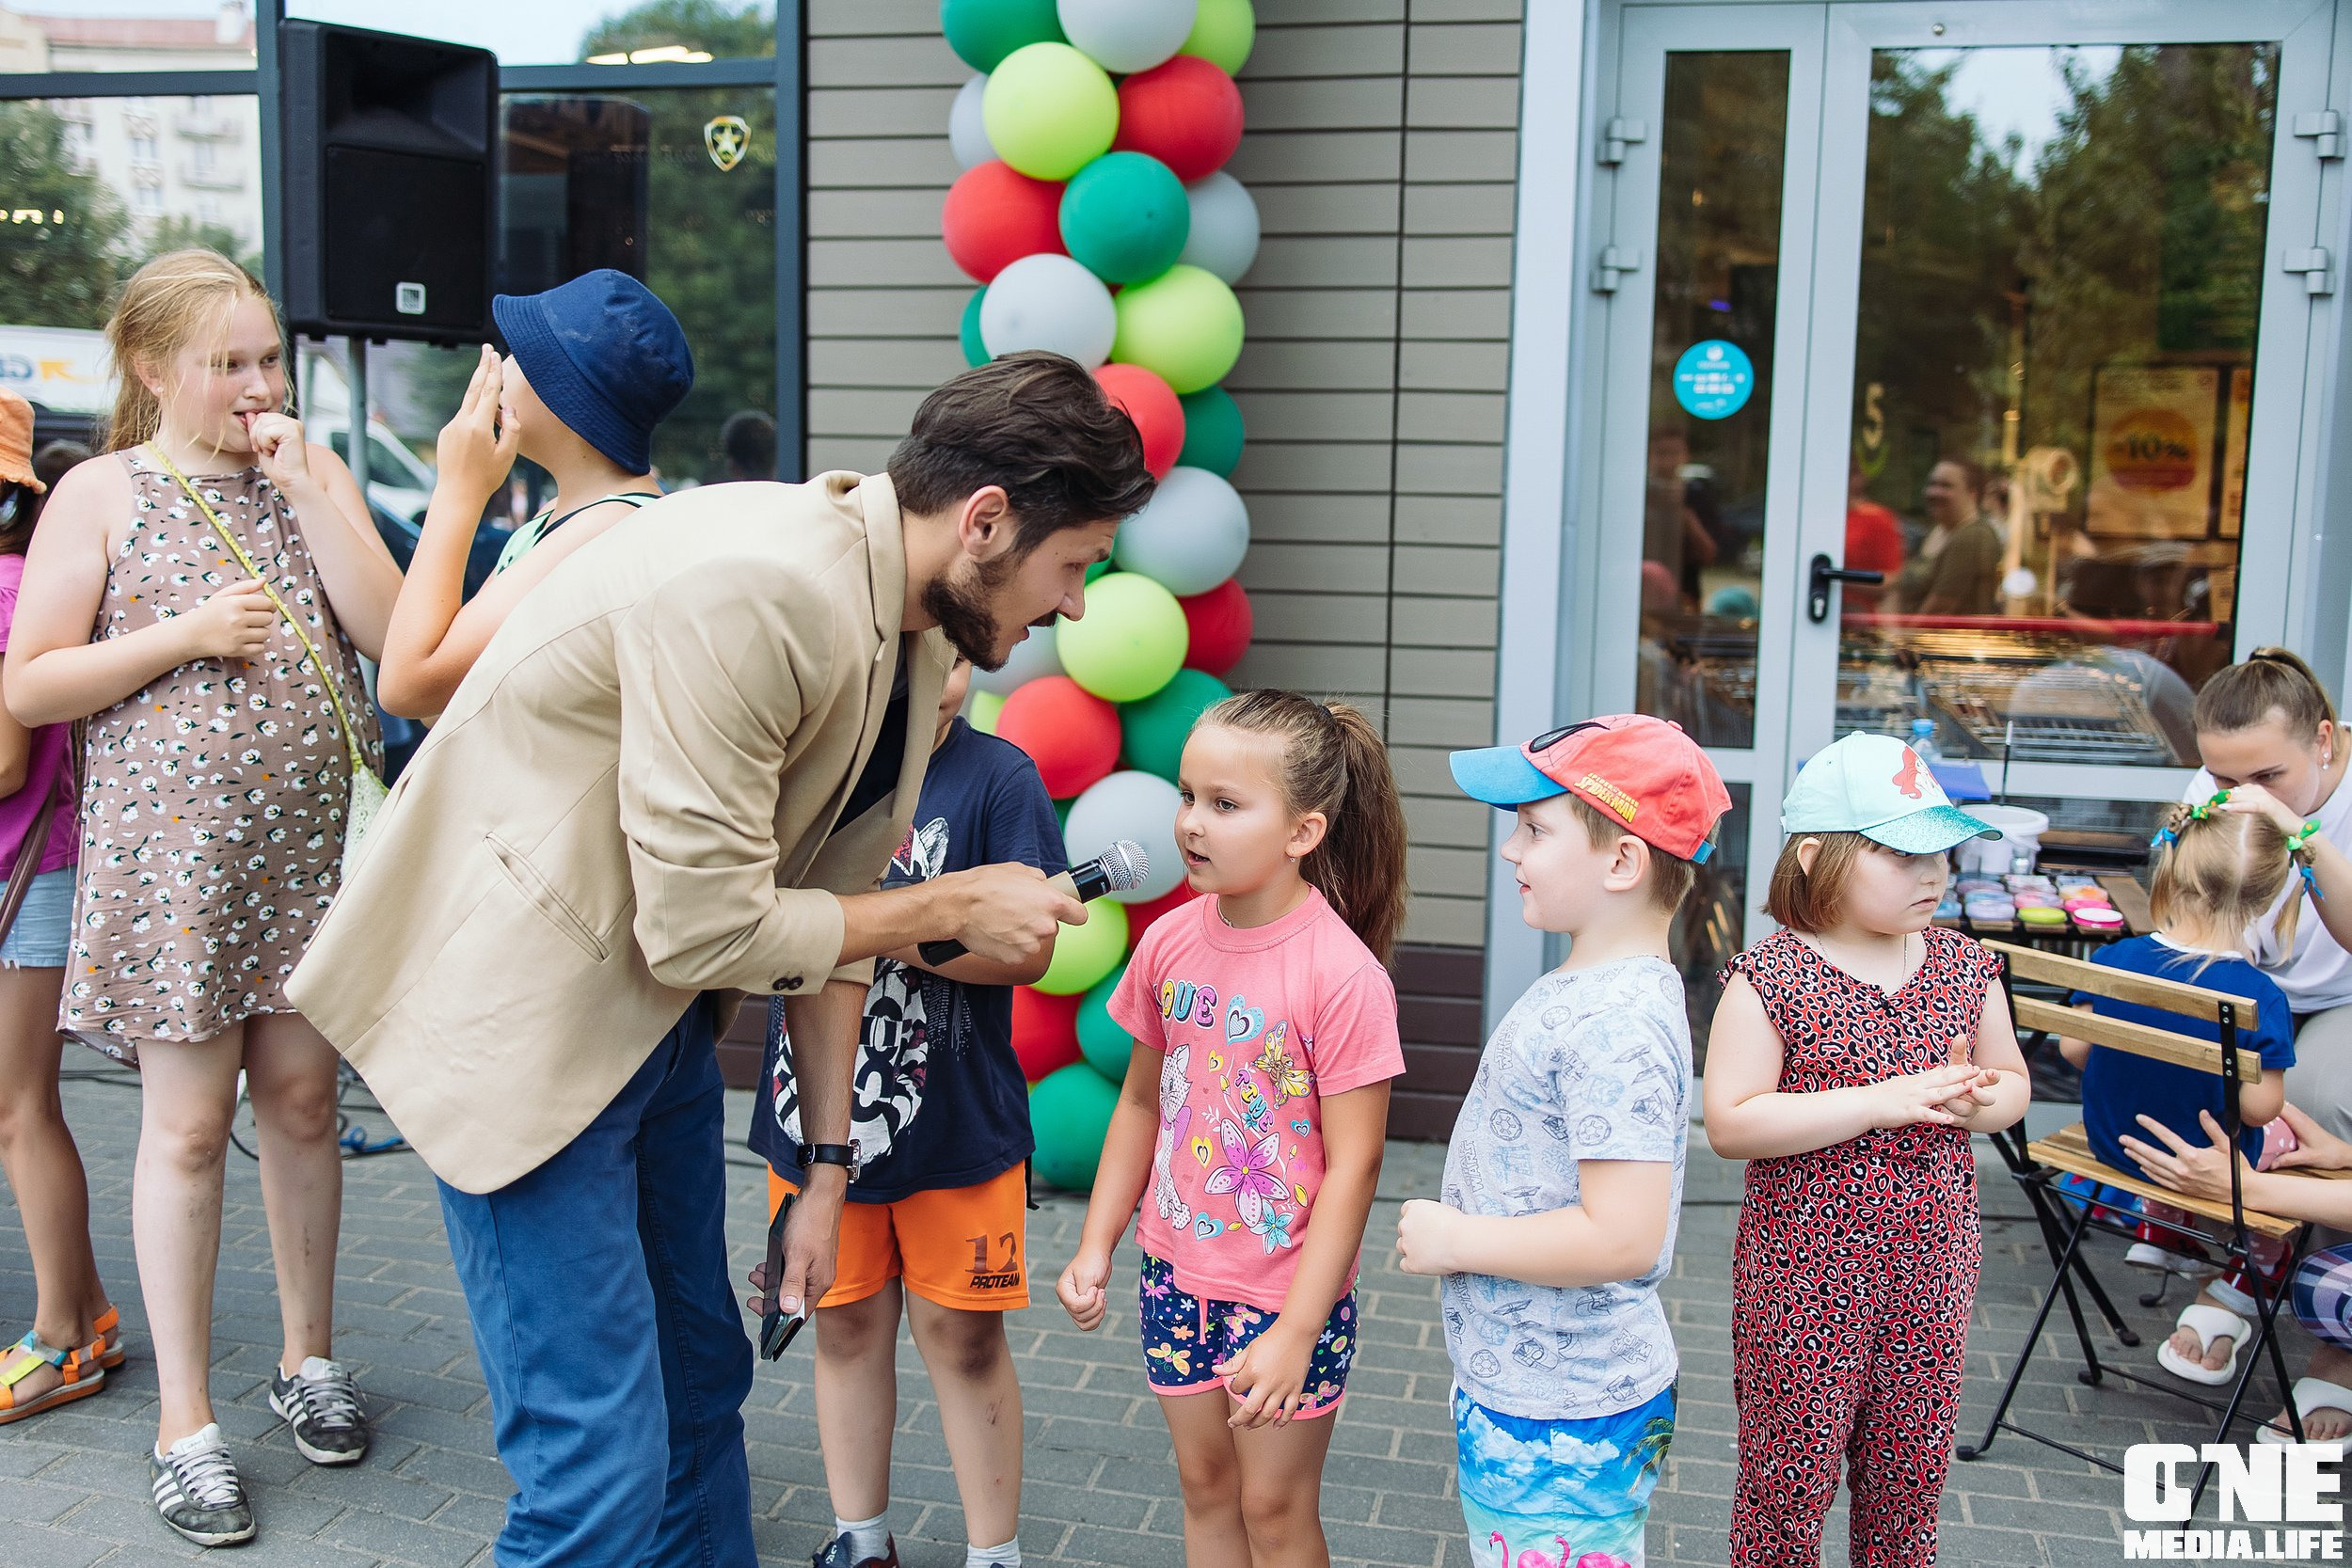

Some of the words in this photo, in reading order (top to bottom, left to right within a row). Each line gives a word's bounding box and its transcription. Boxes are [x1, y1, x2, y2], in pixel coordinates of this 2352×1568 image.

[1234, 1068, 1275, 1133] TIME
[1464, 1140, 1484, 1193] WARS
[964, 1231, 1018, 1274] 12
